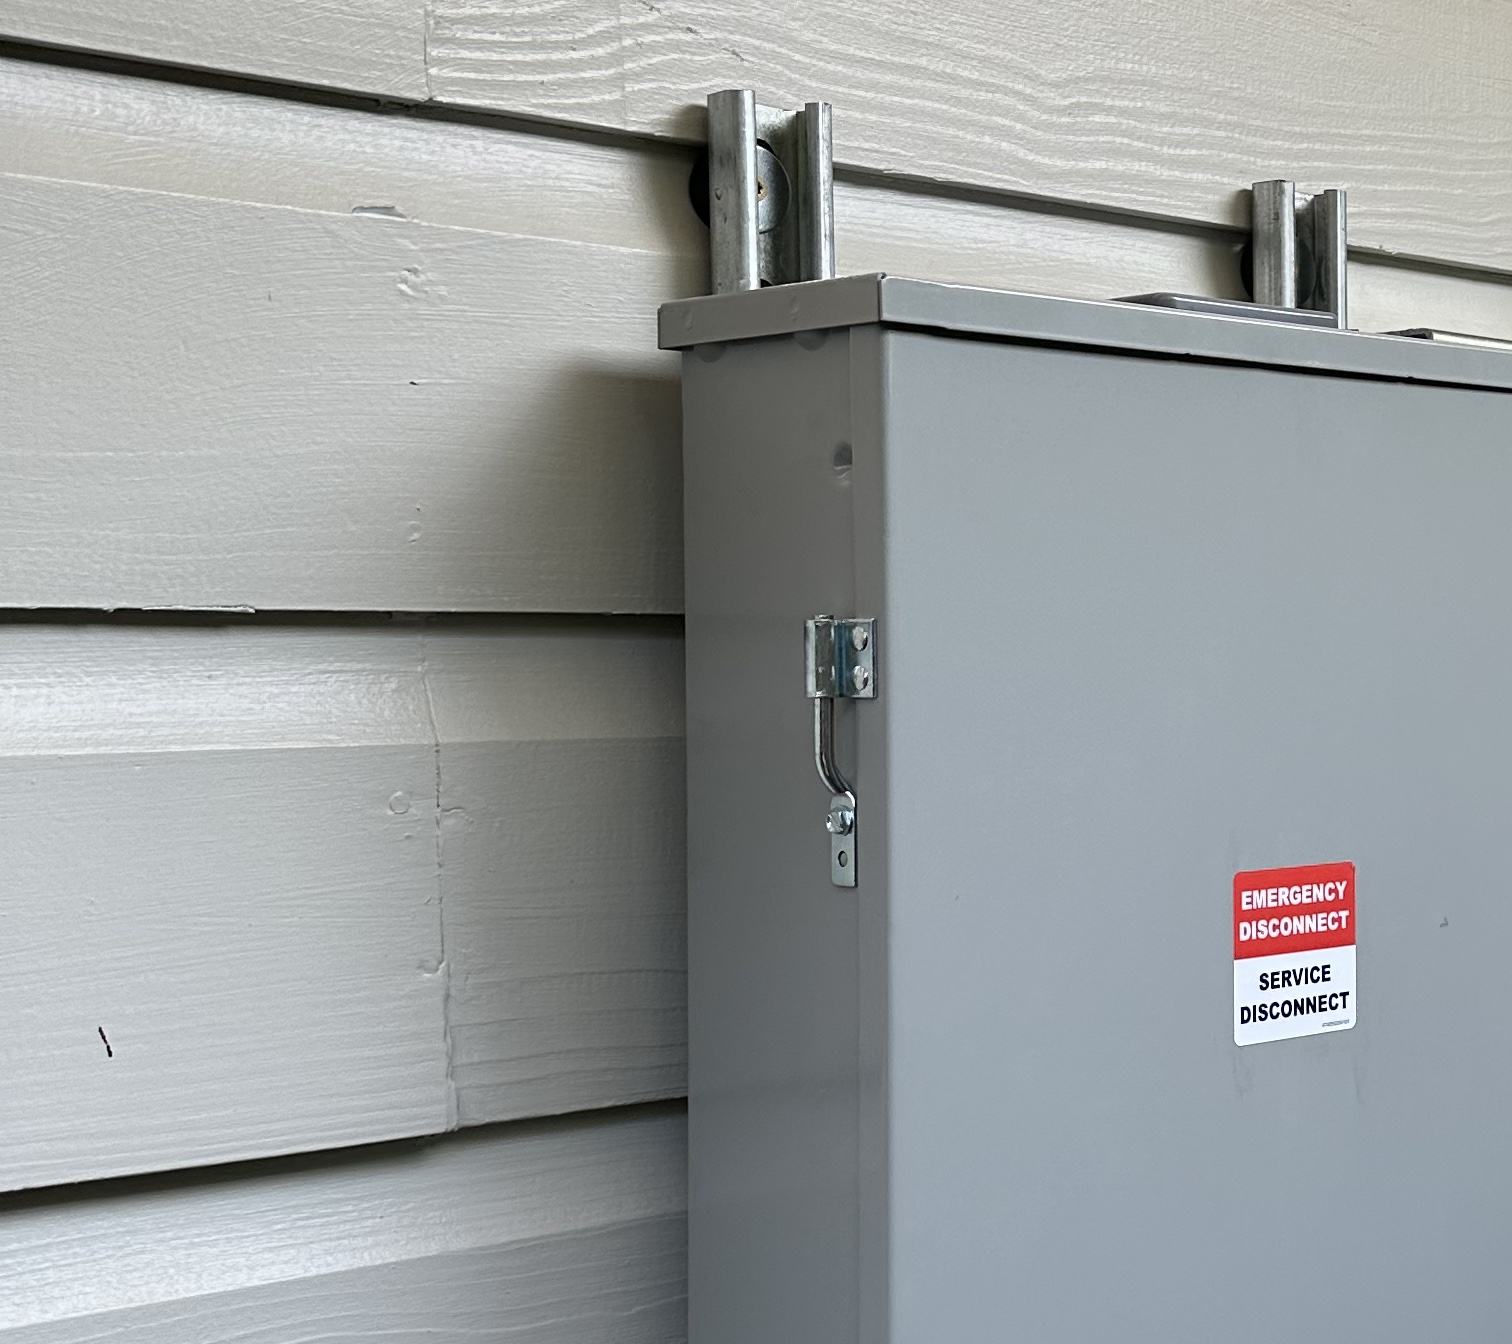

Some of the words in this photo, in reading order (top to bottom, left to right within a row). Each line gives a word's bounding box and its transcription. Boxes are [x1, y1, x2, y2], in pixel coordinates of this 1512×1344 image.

[1241, 880, 1348, 910] EMERGENCY
[1239, 910, 1350, 941] DISCONNECT
[1259, 964, 1331, 991] SERVICE
[1240, 991, 1350, 1024] DISCONNECT
